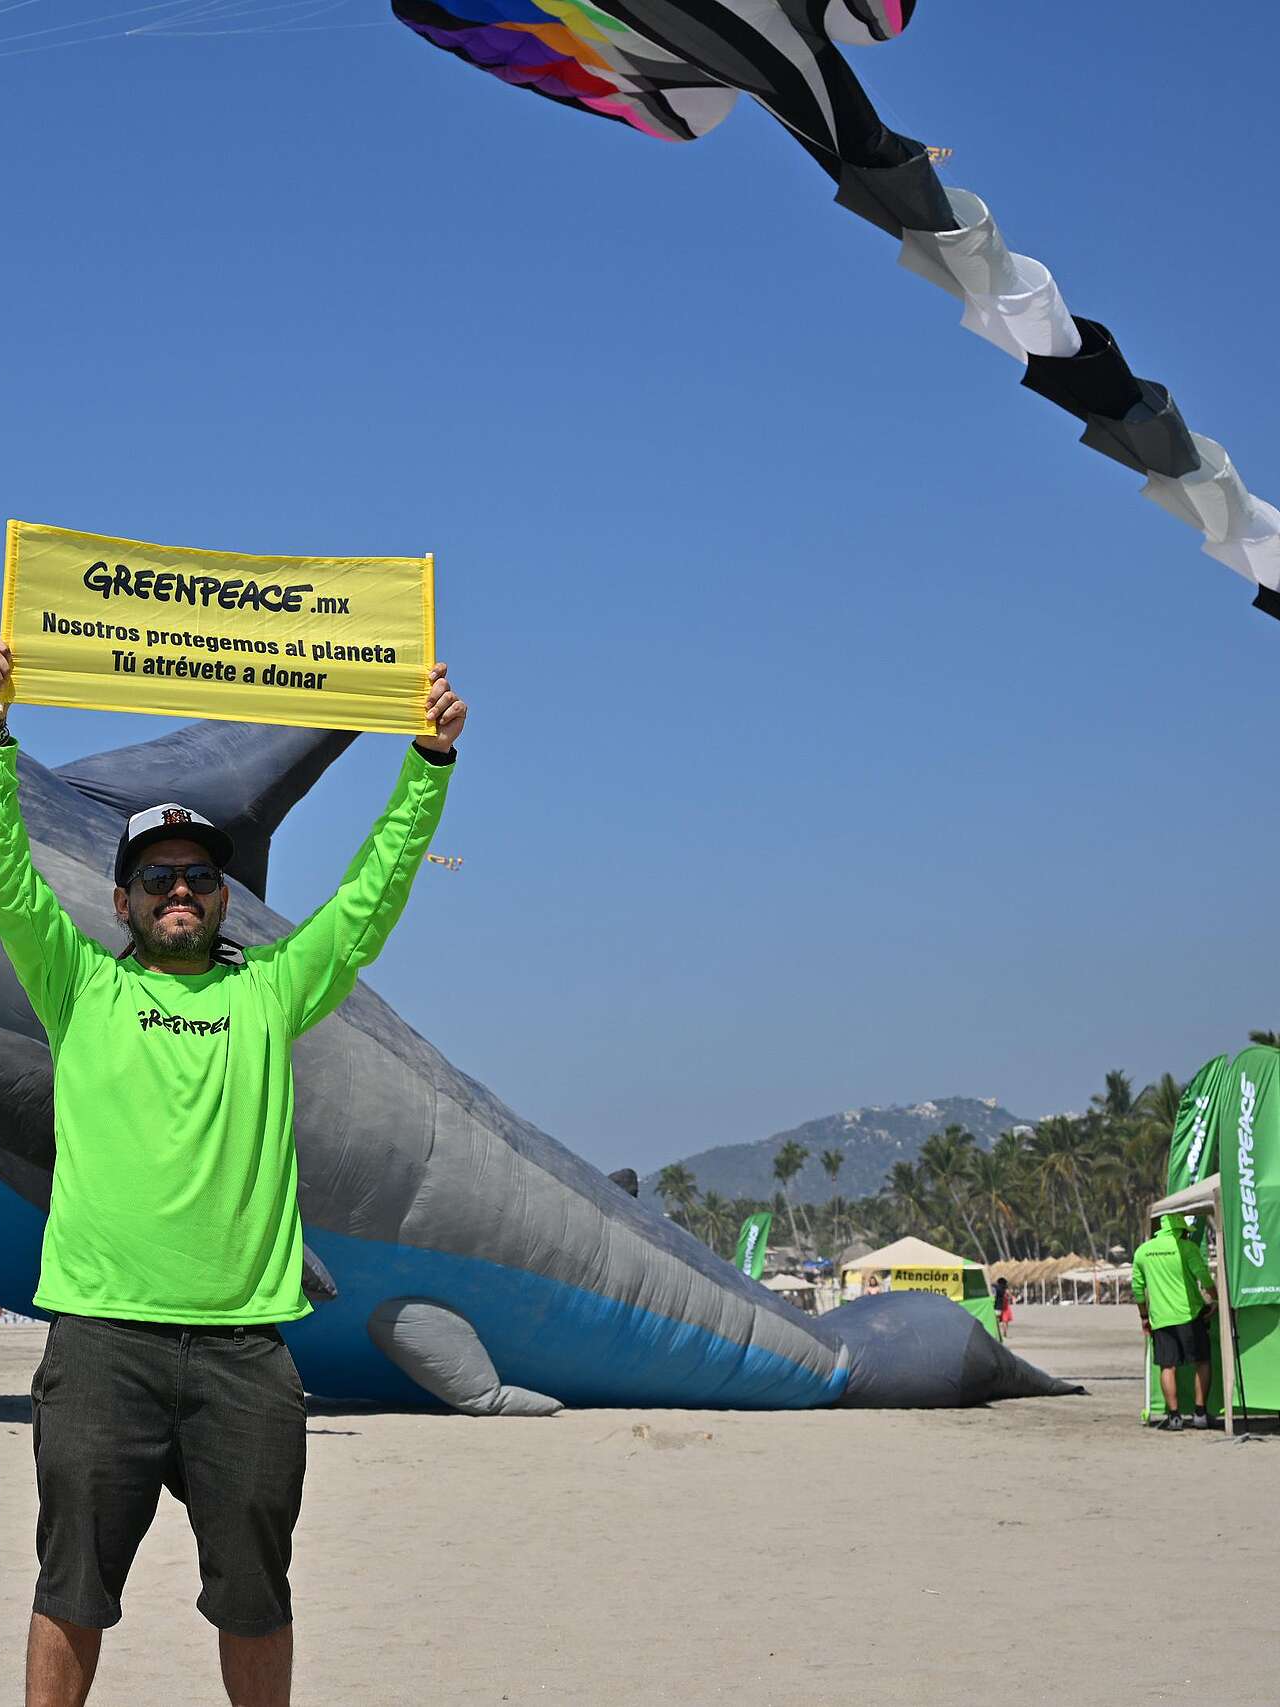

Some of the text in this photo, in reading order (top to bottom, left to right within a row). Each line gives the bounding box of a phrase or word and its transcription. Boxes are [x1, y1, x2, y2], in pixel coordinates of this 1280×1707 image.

[42, 611, 396, 664] Nosotros protegemos al planeta
[112, 650, 327, 690] Tú atrévete a donar
[1237, 1071, 1267, 1269] GREENPEACE
[895, 1270, 960, 1282] Atención a
